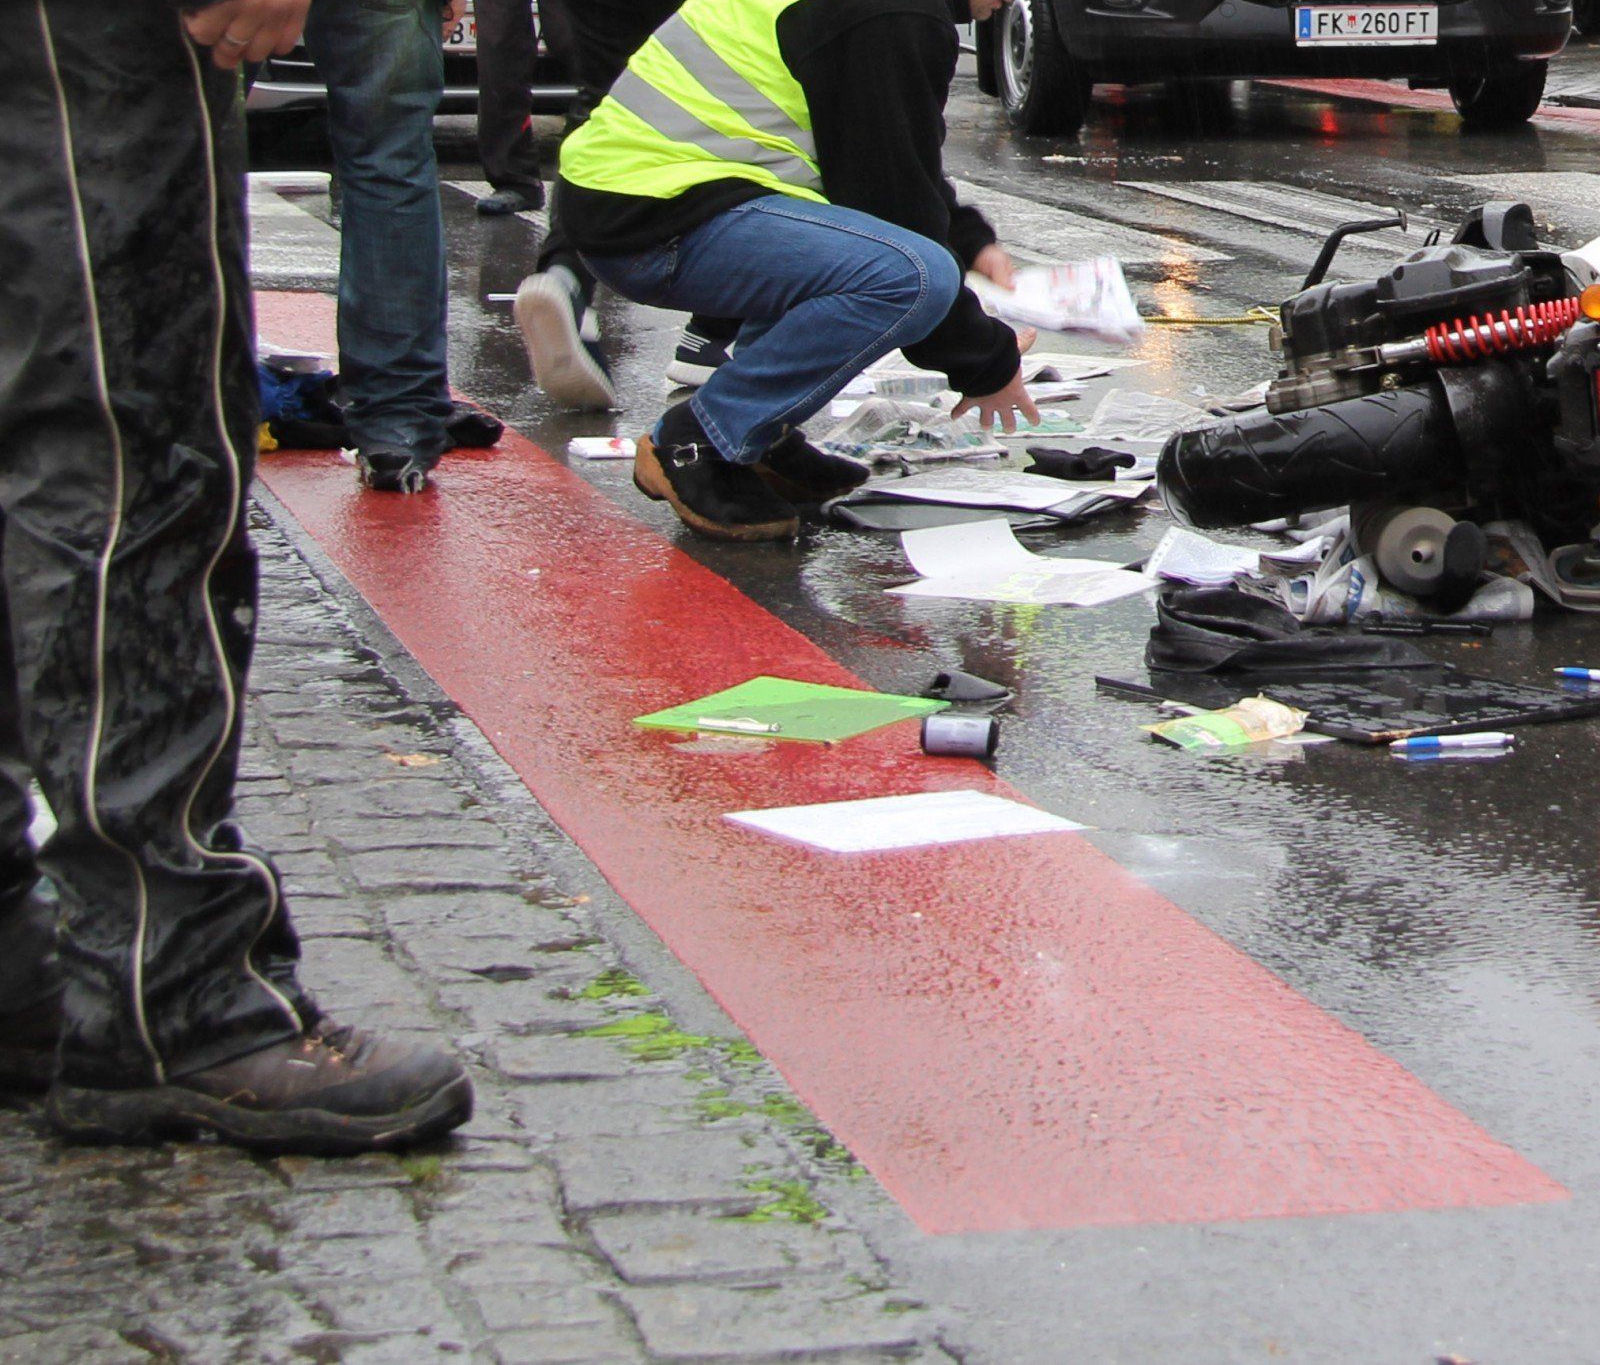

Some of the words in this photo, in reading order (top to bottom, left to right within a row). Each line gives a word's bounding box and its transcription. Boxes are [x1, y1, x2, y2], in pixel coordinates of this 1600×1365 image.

[1318, 12, 1343, 34] FK
[1361, 12, 1399, 34] 260
[1406, 12, 1430, 33] FT
